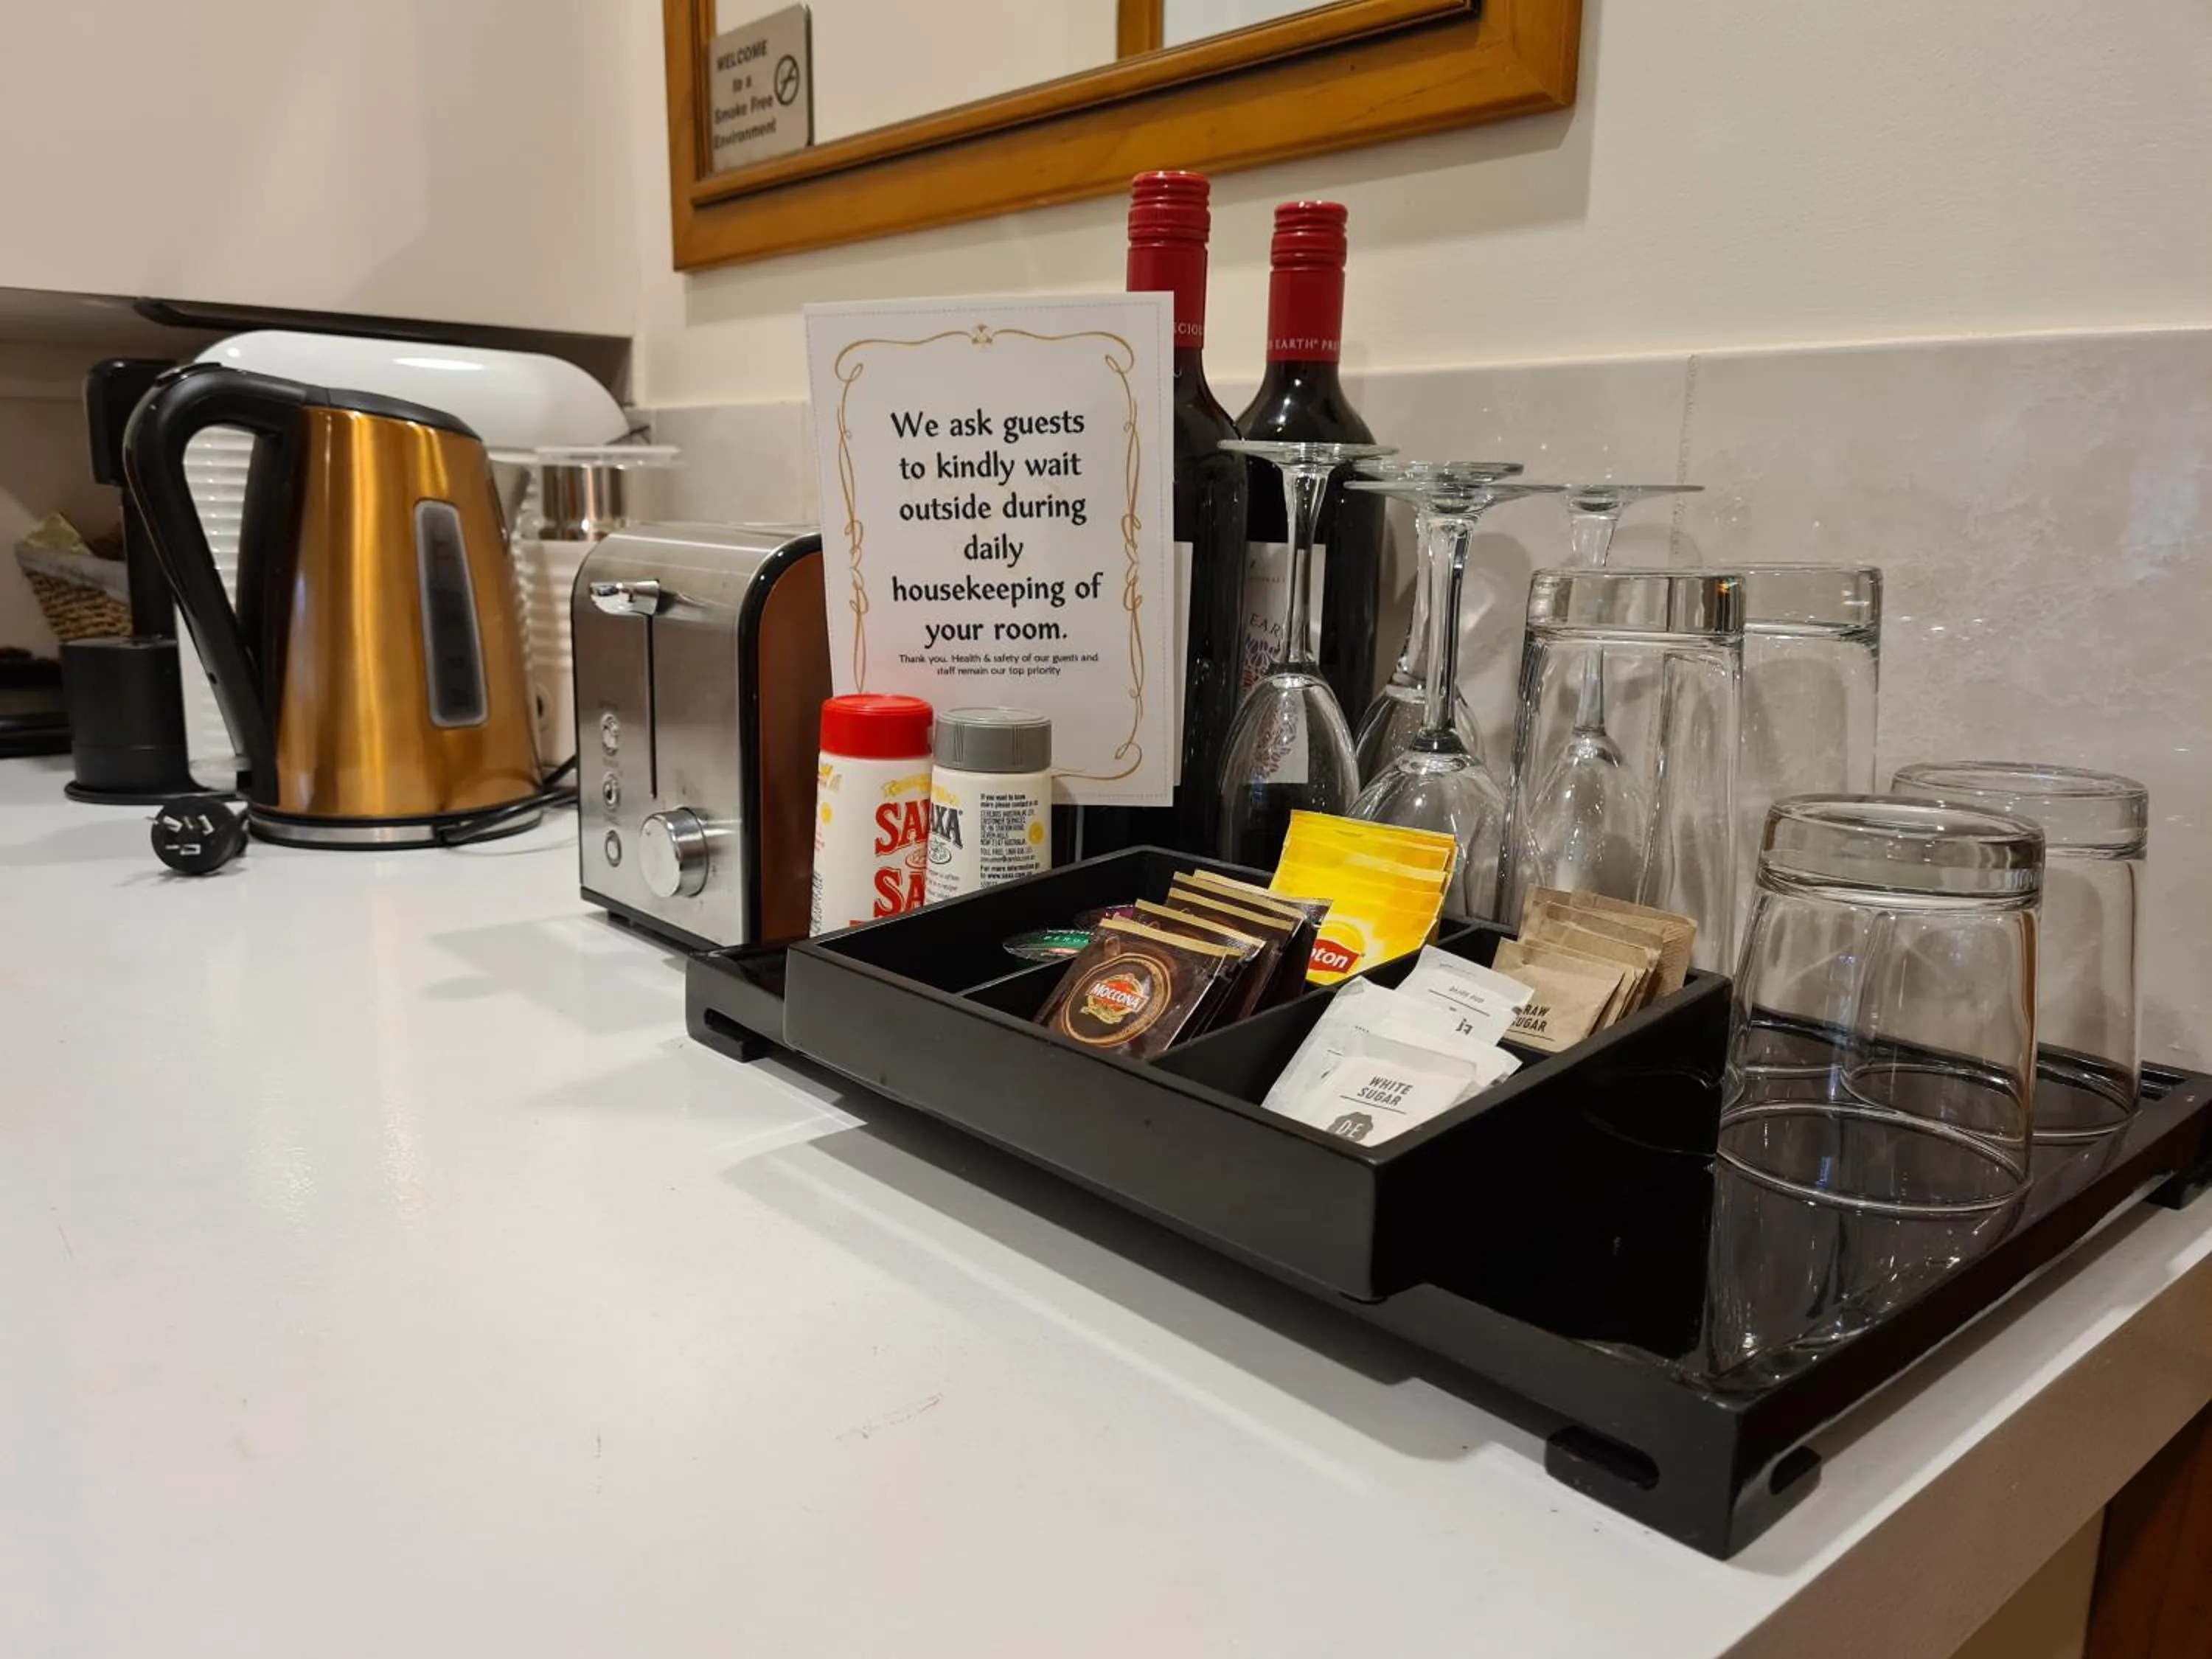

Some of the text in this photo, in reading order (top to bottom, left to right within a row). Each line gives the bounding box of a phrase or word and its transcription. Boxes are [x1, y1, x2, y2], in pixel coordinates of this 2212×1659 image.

[716, 40, 768, 71] WELCOME
[732, 76, 752, 93] to a
[715, 94, 773, 125] Smoke Free
[714, 118, 776, 150] Environment
[890, 408, 1085, 444] We ask guests
[899, 450, 1082, 486] to kindly wait
[899, 492, 1087, 526] outside during
[964, 532, 1023, 568] daily
[891, 572, 1104, 608] housekeeping of
[924, 622, 1068, 649] your room.
[899, 654, 926, 663] Thank
[951, 654, 981, 663] Health
[984, 654, 991, 663] &
[993, 653, 1019, 664] safety
[1021, 653, 1032, 662] of
[1052, 654, 1078, 664] guests
[1080, 653, 1099, 662] and
[937, 665, 1061, 677] staff remain our top priority
[1091, 982, 1140, 1009] MOCCONA
[1523, 1004, 1551, 1018] RAW
[1357, 1088, 1402, 1106] SUGAR
[1369, 1077, 1413, 1095] WHITE
